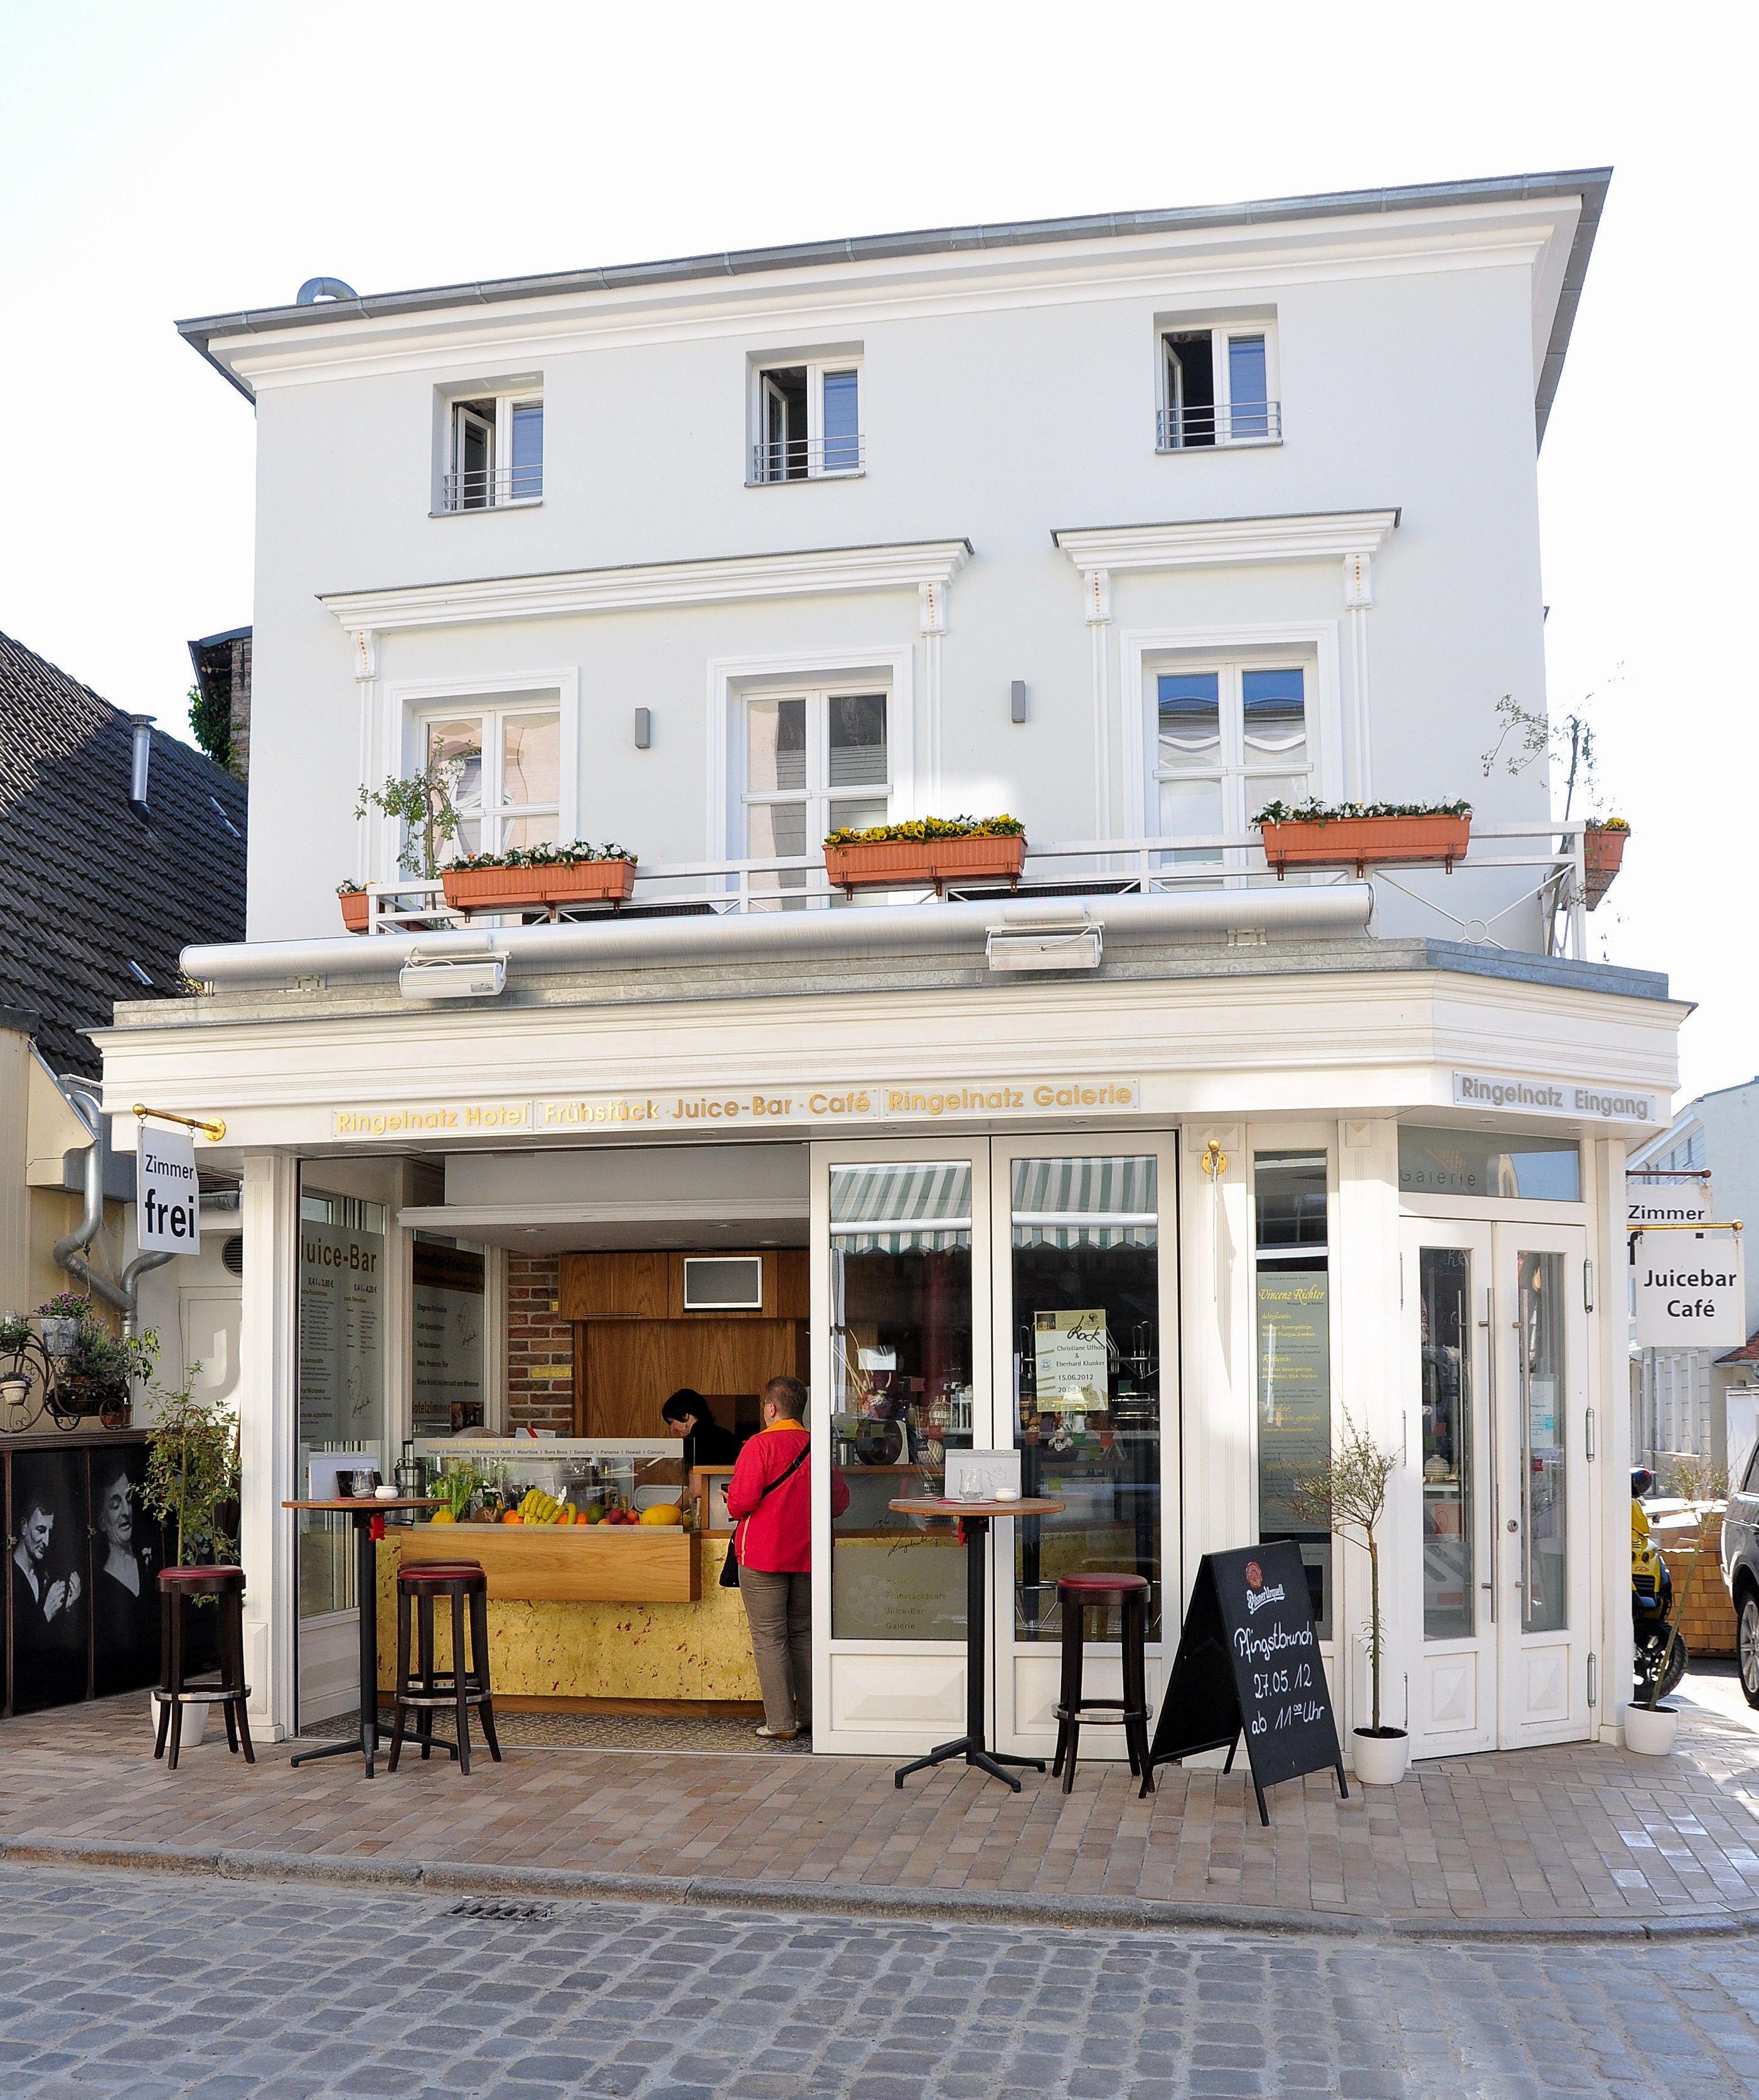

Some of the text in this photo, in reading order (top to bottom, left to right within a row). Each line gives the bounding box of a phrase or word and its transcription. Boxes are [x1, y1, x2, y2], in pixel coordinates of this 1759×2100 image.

[544, 1090, 870, 1123] Frühstück Juice-Bar Café
[888, 1083, 1132, 1115] Ringelnatz Galerie
[1463, 1076, 1649, 1120] Ringelnatz Eingang
[336, 1105, 528, 1136] Ringelnatz Hotel
[145, 1154, 194, 1180] Zimmer
[1399, 1169, 1477, 1187] Galerie
[144, 1188, 195, 1239] frei
[1628, 1204, 1705, 1221] Zimmer
[1644, 1269, 1737, 1288] Juicebar
[1258, 1284, 1325, 1305] Vincenz Richter
[1667, 1299, 1716, 1317] Café
[1234, 1621, 1313, 1663] Pfingstbrunch
[1251, 1710, 1268, 1735] ab
[1303, 1700, 1325, 1722] Uhr
